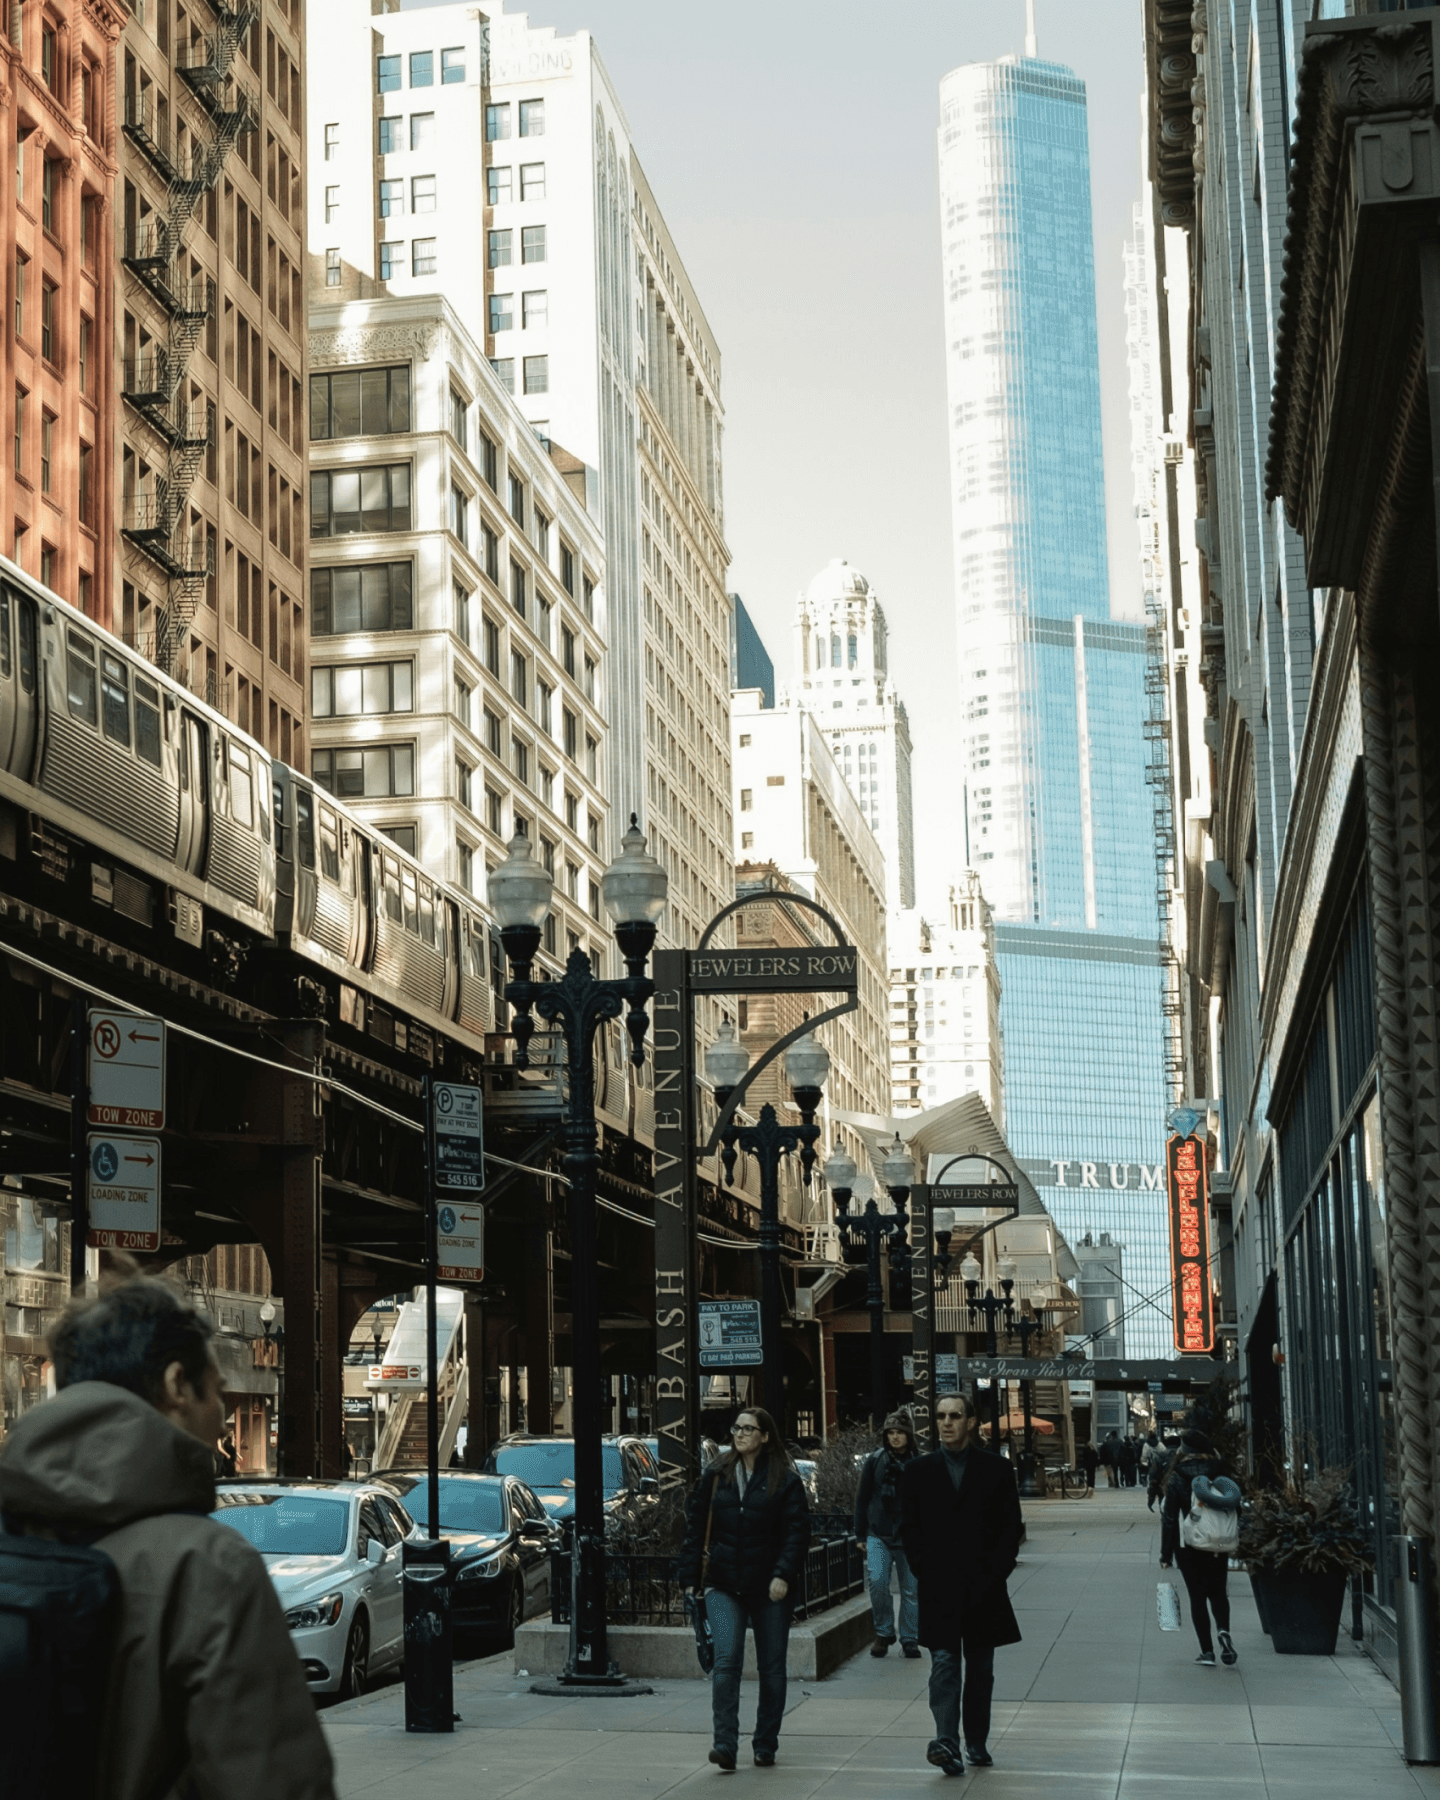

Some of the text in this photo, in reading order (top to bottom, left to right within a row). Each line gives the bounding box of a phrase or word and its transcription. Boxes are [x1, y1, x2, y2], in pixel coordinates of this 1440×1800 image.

[688, 955, 857, 977] JEWELERS ROW
[96, 1107, 156, 1126] TOW ZONE
[447, 1174, 478, 1186] 545 516
[1049, 1159, 1166, 1191] TRUM
[91, 1188, 149, 1203] LOADING ZONE
[930, 1188, 1018, 1200] JEWELERS ROW
[95, 1230, 151, 1248] TOW ZONE
[651, 989, 687, 1491] WABASH AVENUE
[1173, 1141, 1204, 1349] JEWELERS CENTER
[912, 1204, 928, 1320] AVENUE
[441, 1266, 478, 1279] TOW ZONE
[731, 1303, 754, 1311] PARK
[989, 1360, 1029, 1377] Iwan
[1032, 1361, 1064, 1377] Ries
